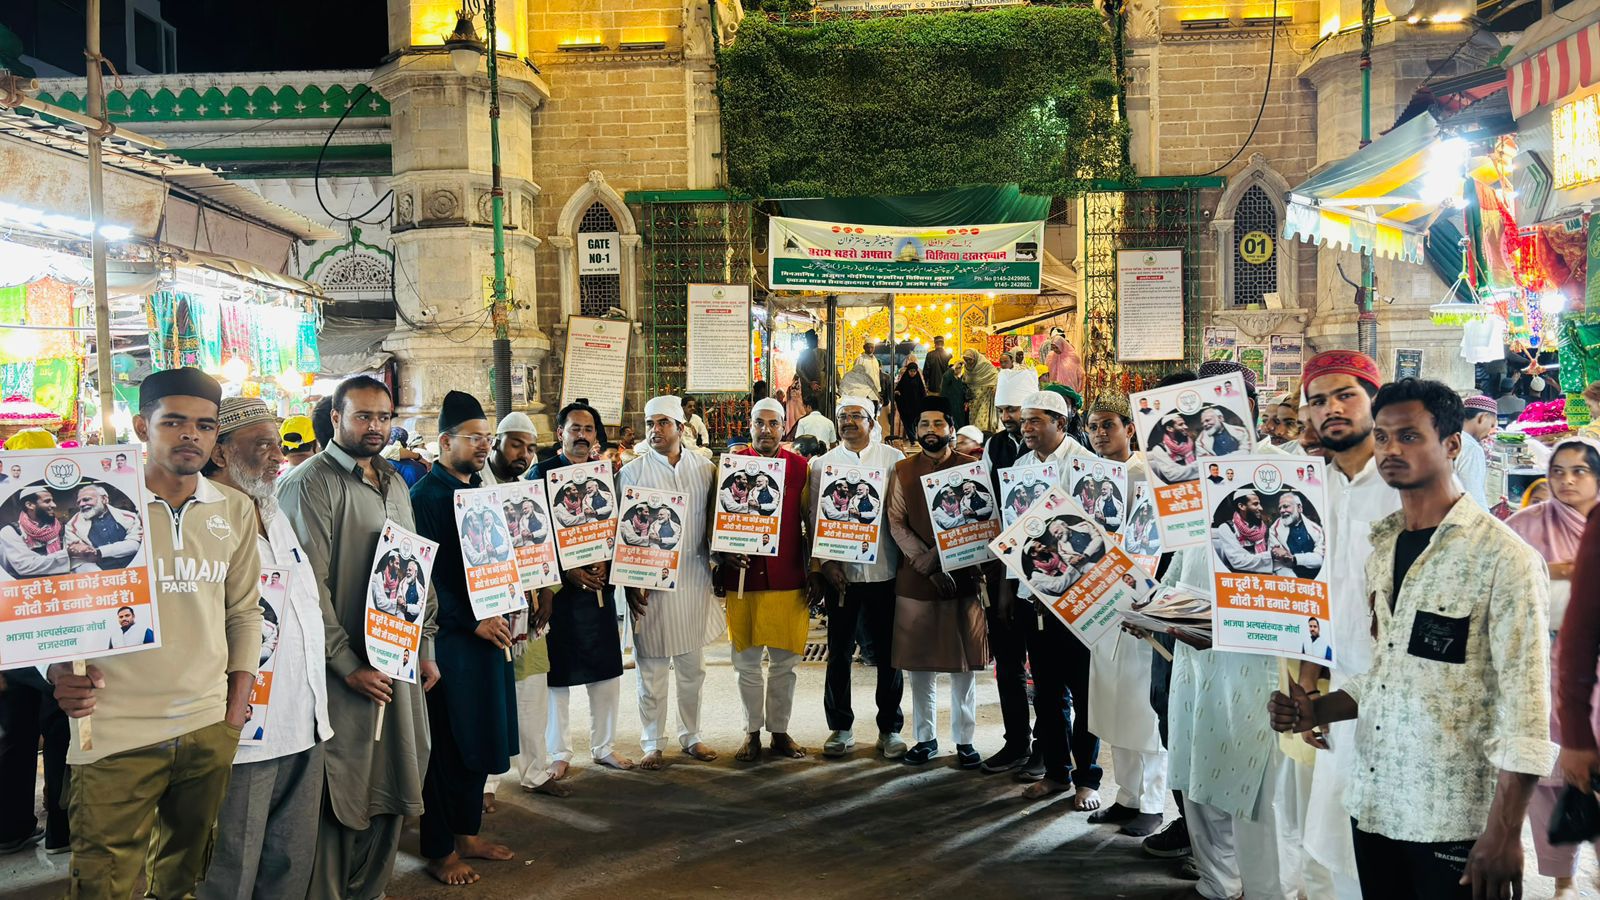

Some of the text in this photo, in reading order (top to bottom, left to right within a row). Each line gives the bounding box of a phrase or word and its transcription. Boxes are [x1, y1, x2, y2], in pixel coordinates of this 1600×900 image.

[588, 239, 609, 249] GATE
[1245, 239, 1265, 254] 01
[589, 253, 609, 263] NO-1
[154, 557, 230, 583] LMAIN
[2, 570, 142, 600] ना दूरी है, ना कोई खाई है,
[162, 582, 198, 593] PARIS
[1220, 576, 1325, 599] ना दूरी है, ना कोई खाई है,
[14, 589, 135, 616] मोदी जी हमारे भाई हैं।
[1229, 593, 1320, 615] मोदी जी हमारे भाई हैं।
[6, 620, 107, 642] भाजपा अल्पसंख्यक मोर्चा
[1224, 619, 1300, 633] भाजपा अल्पसंख्यक मोर्चा
[38, 637, 77, 650] राजस्थान
[1247, 632, 1278, 641] राजस्थान
